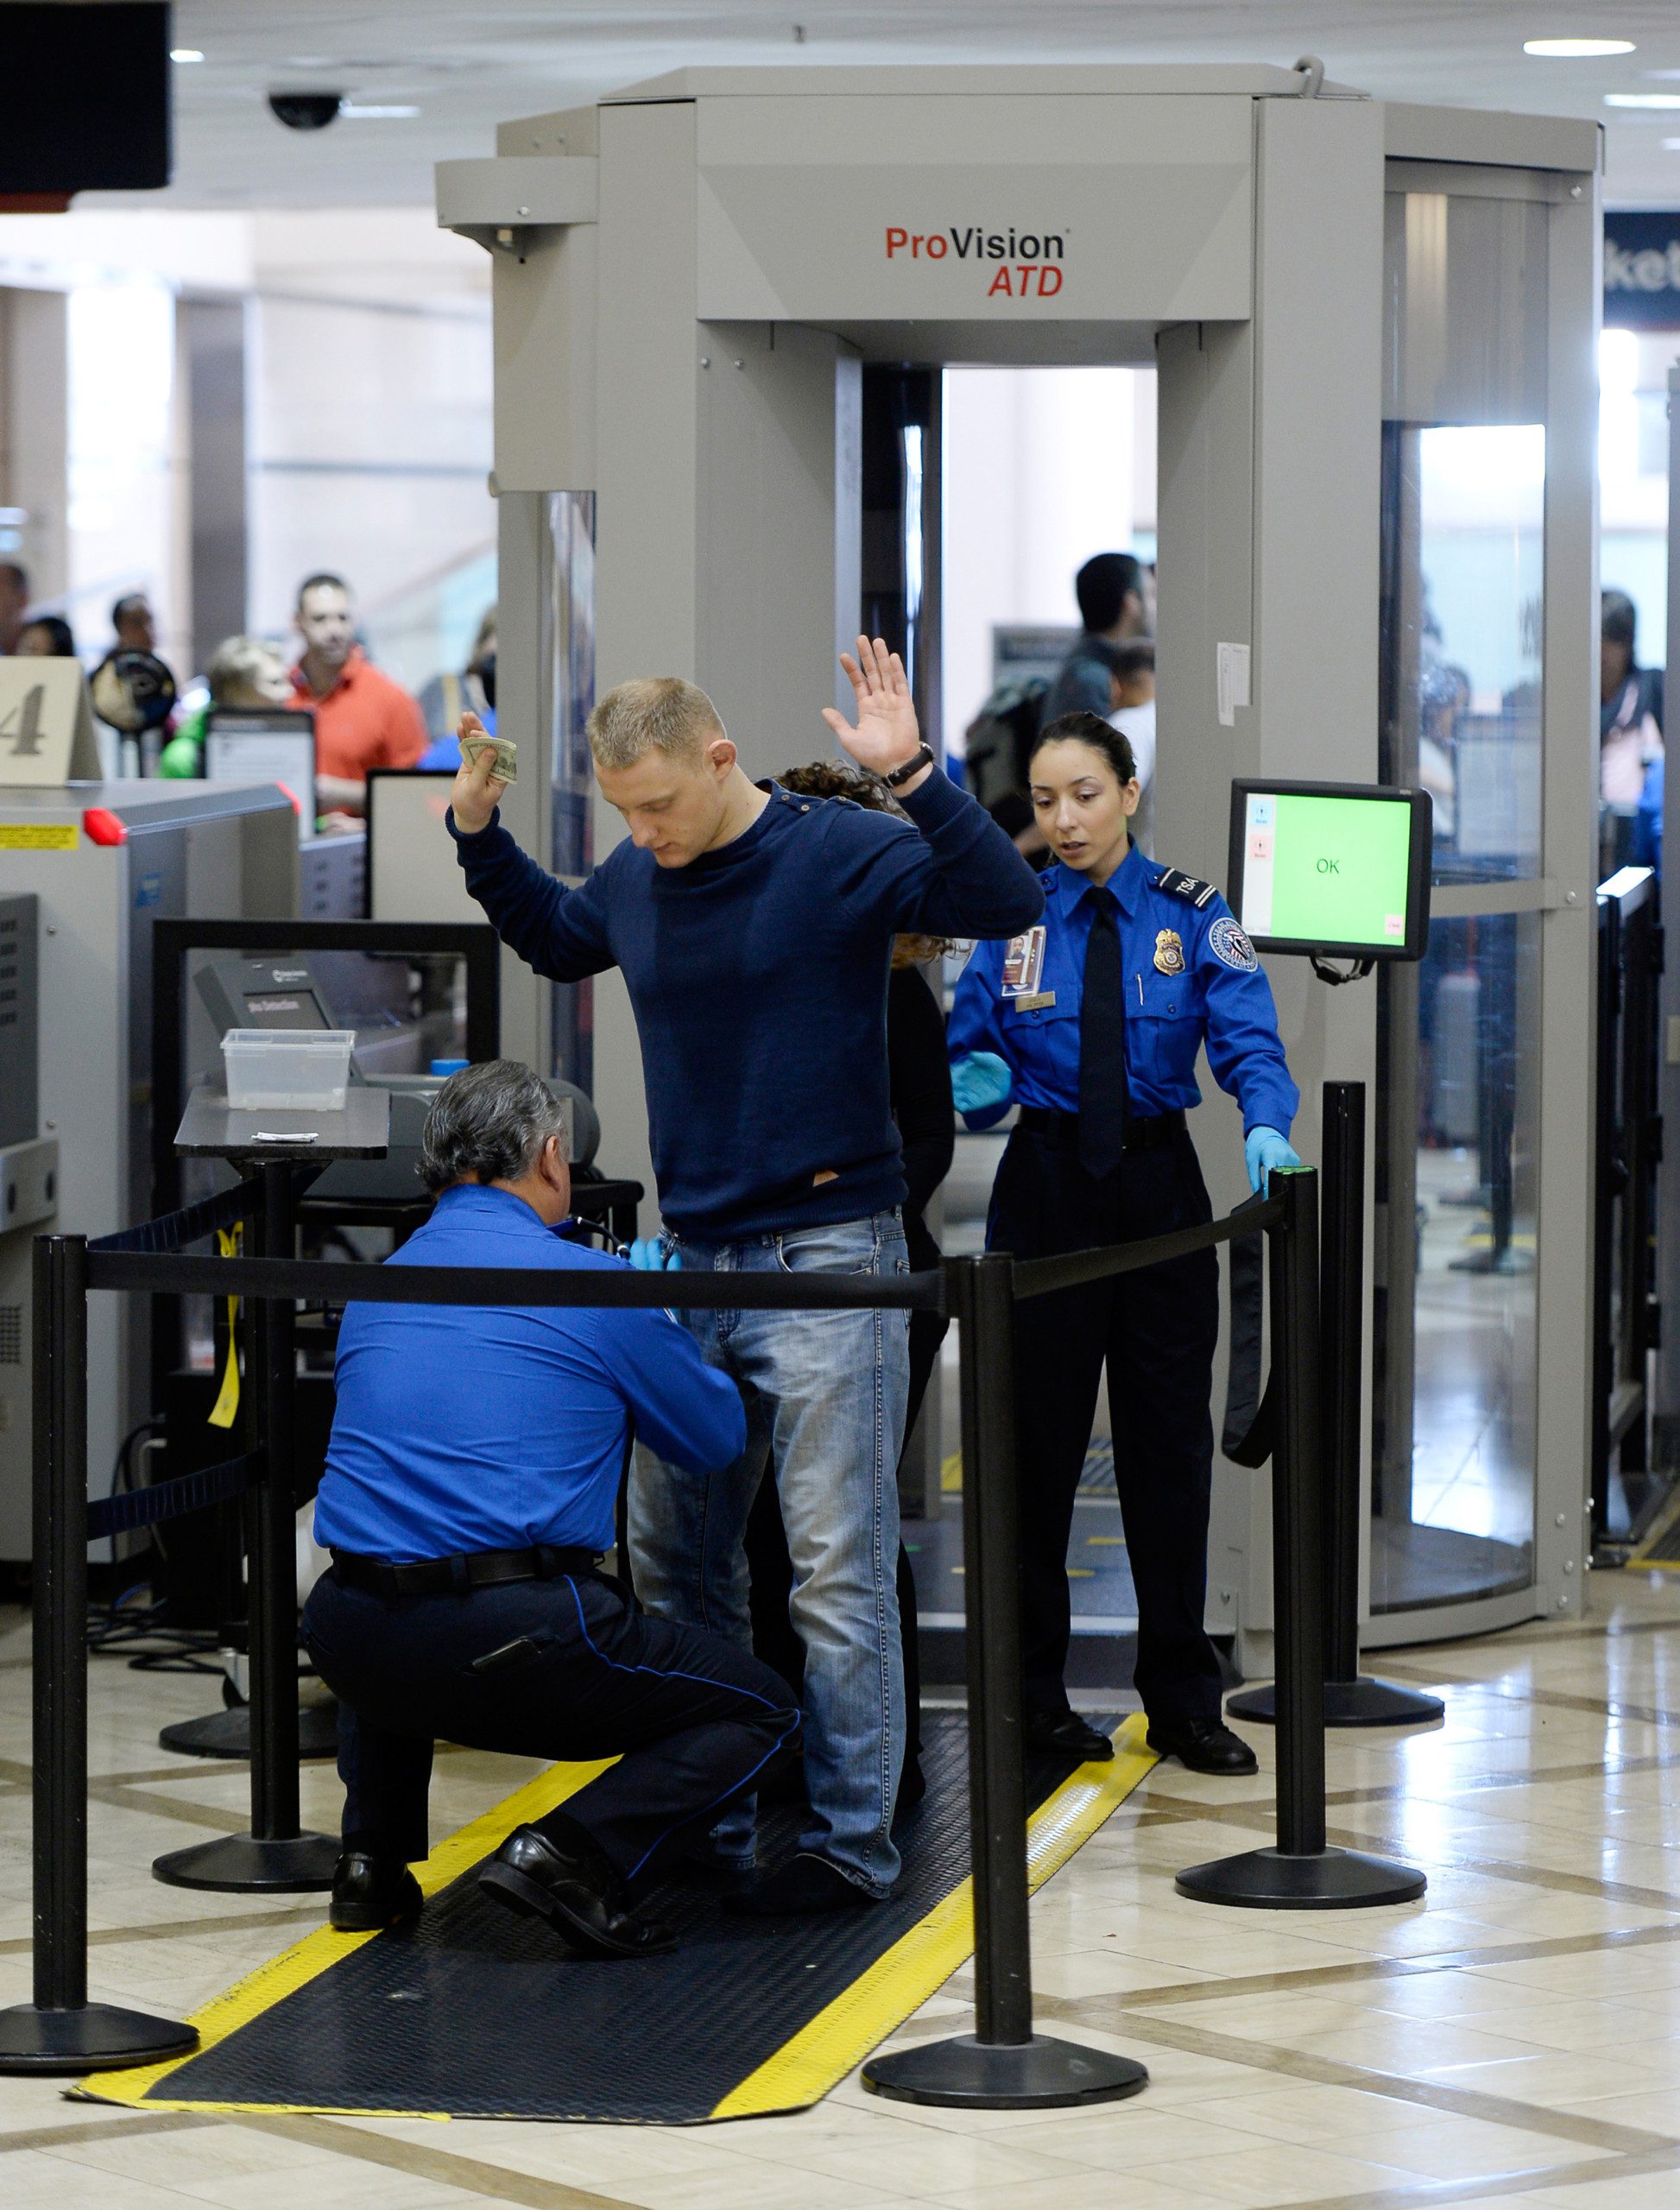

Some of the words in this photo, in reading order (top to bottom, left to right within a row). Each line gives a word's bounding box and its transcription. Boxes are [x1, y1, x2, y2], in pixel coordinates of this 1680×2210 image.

[886, 227, 1064, 259] ProVision
[988, 265, 1064, 297] ATD
[0, 683, 46, 757] 4
[1317, 858, 1340, 874] OK
[1176, 877, 1199, 894] TSA
